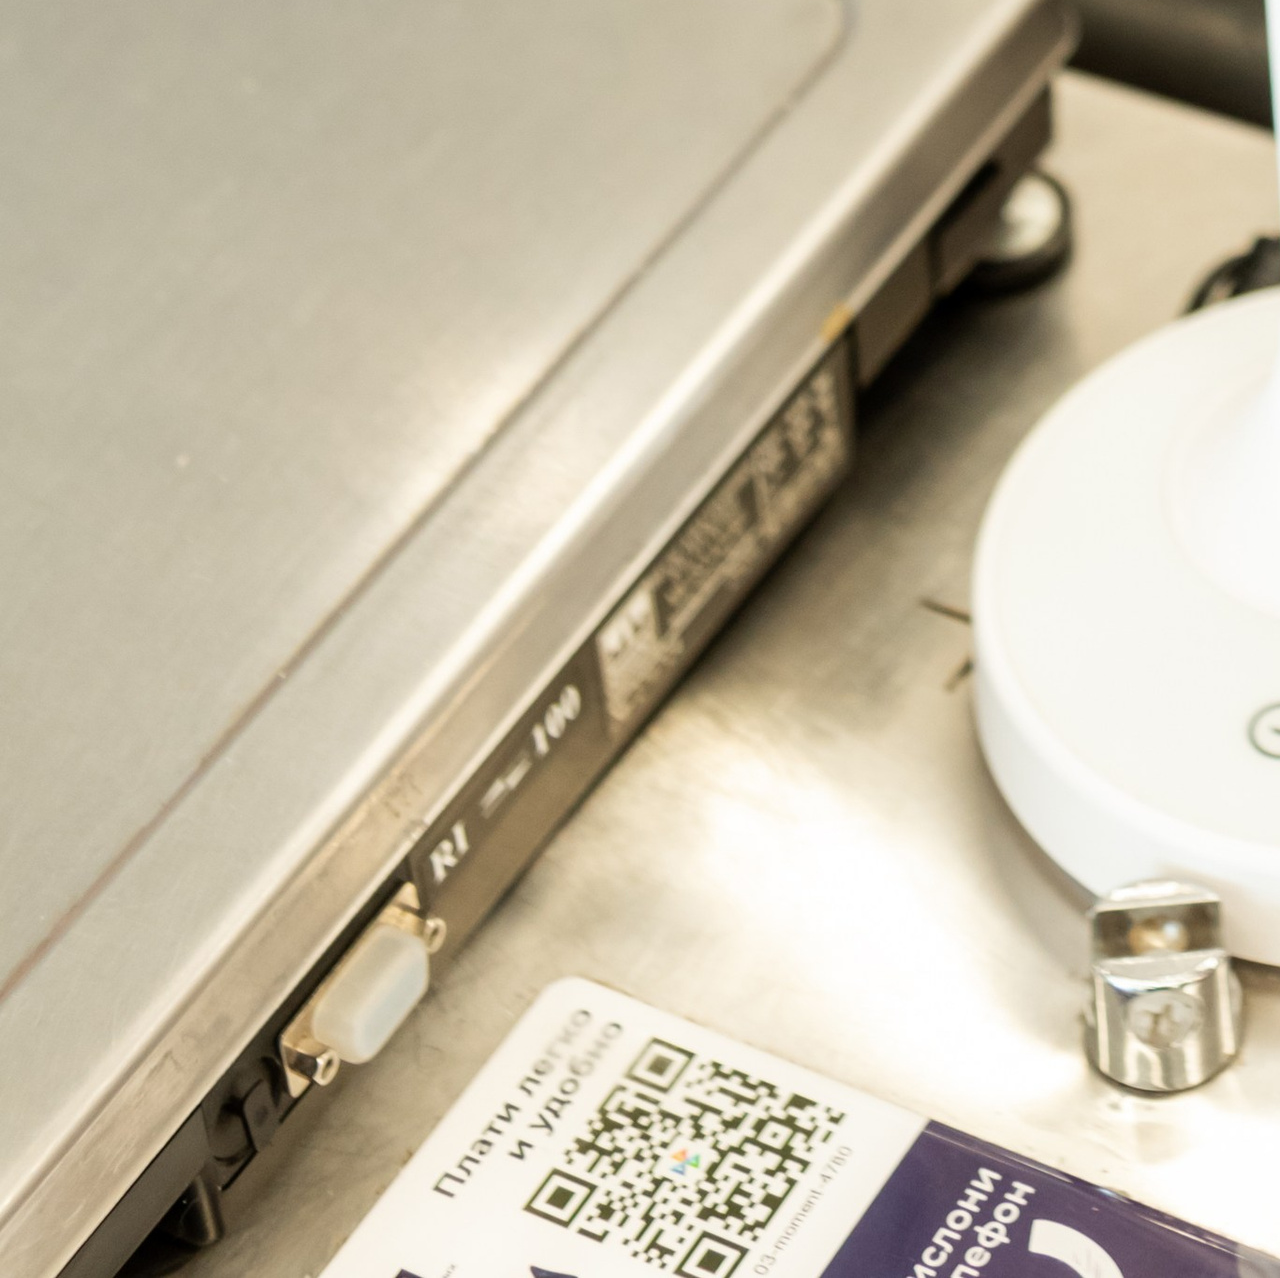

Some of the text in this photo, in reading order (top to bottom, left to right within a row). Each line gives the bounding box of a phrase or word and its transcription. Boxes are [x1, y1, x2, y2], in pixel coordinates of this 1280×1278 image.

[532, 683, 582, 757] 100
[433, 1009, 592, 1198] Плати легко
[508, 1022, 622, 1162] и удобно
